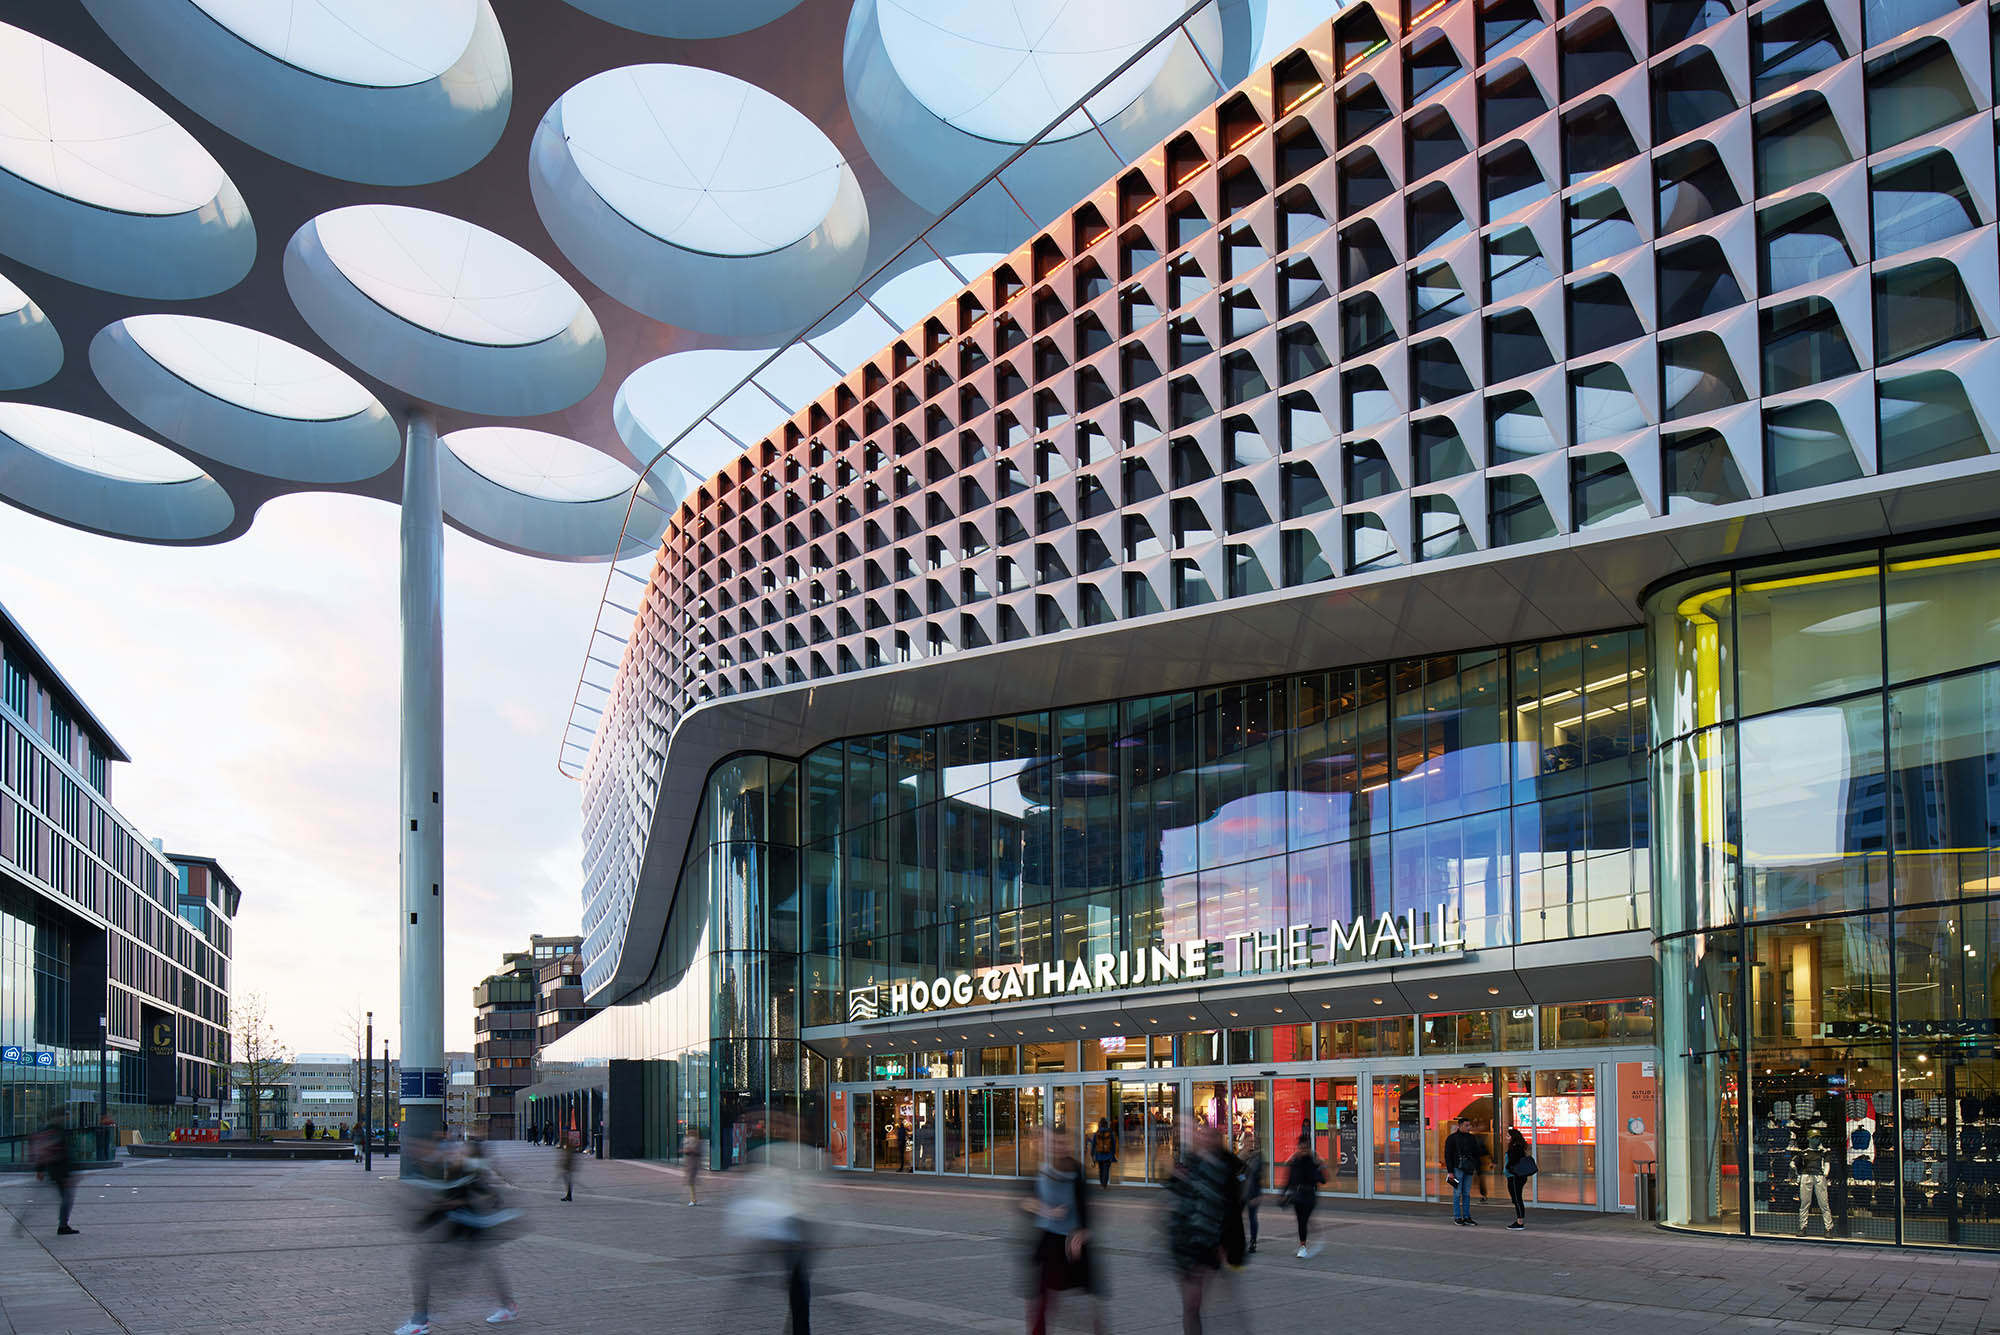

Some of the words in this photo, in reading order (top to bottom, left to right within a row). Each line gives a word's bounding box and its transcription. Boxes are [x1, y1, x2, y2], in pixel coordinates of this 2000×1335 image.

[891, 974, 974, 1013] HOOG
[982, 939, 1207, 1001] CATHARIJNE
[1225, 924, 1312, 972] THE
[1330, 903, 1464, 960] MALL
